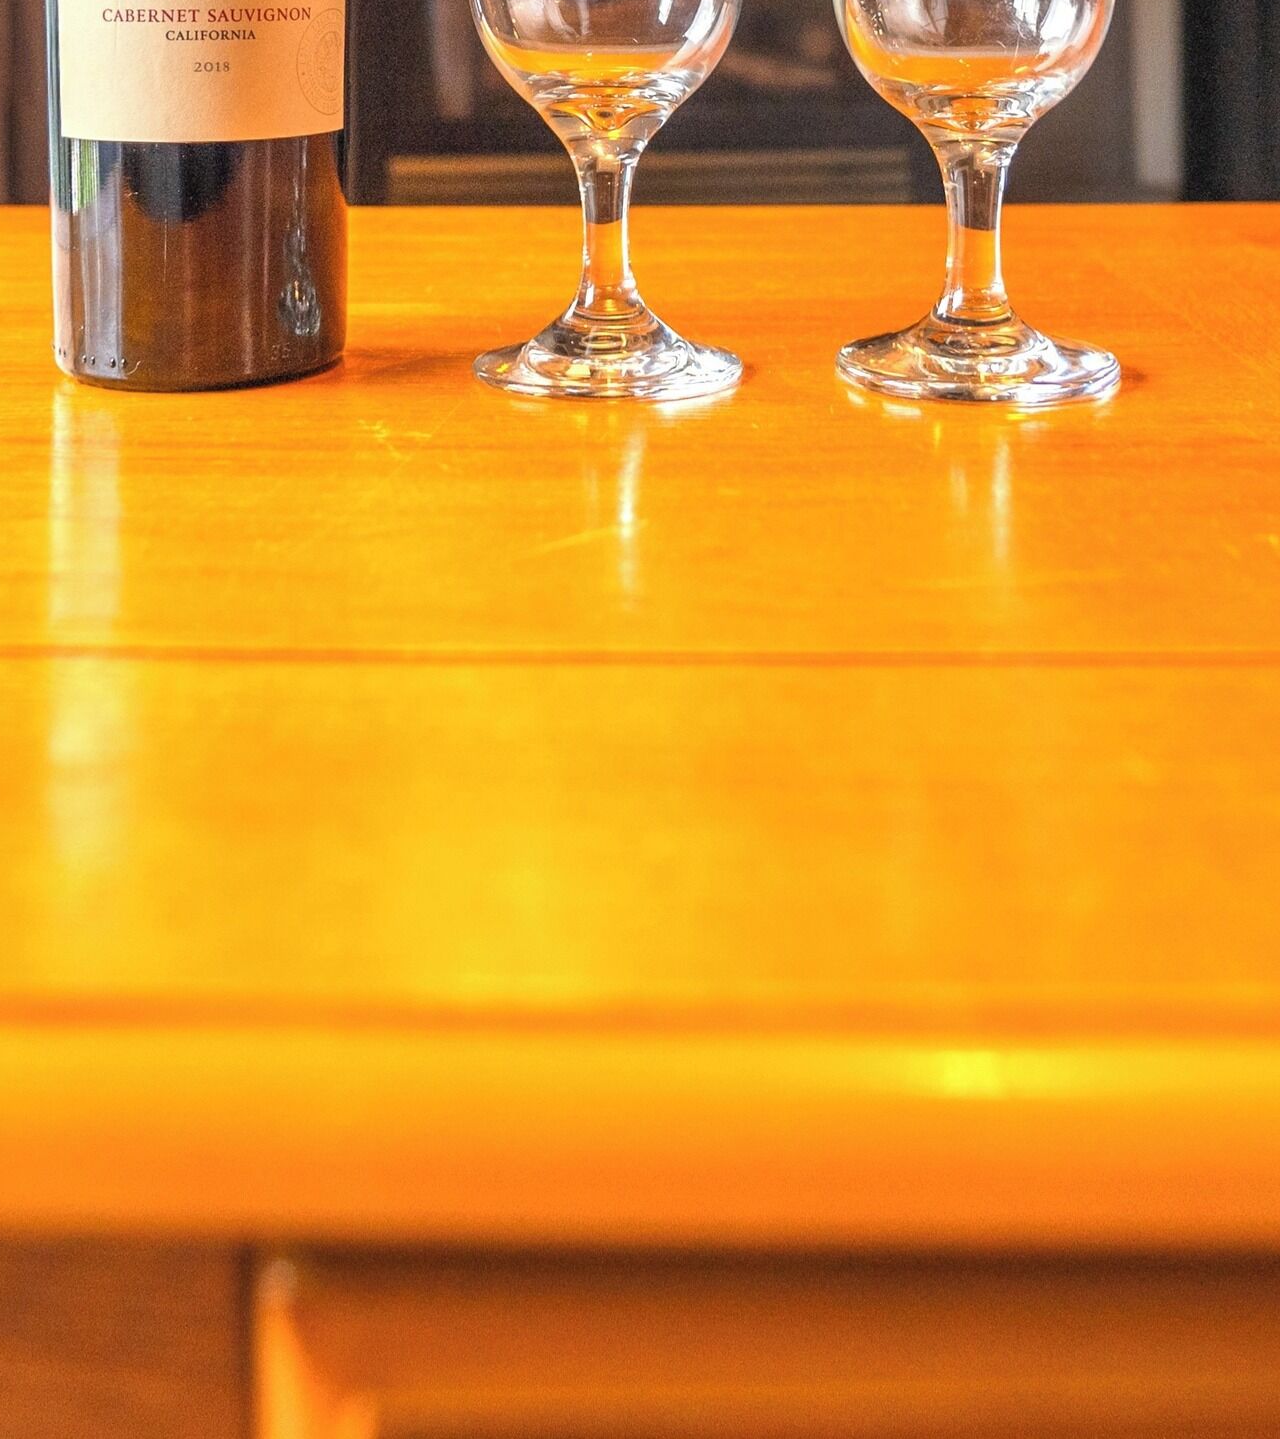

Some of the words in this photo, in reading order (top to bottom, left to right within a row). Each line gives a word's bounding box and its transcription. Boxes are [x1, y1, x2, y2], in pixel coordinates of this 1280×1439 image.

[102, 8, 200, 23] CABERNET
[207, 7, 312, 23] SAUVIGNON
[165, 29, 257, 41] CALIFORNIA
[193, 61, 231, 73] 2018
